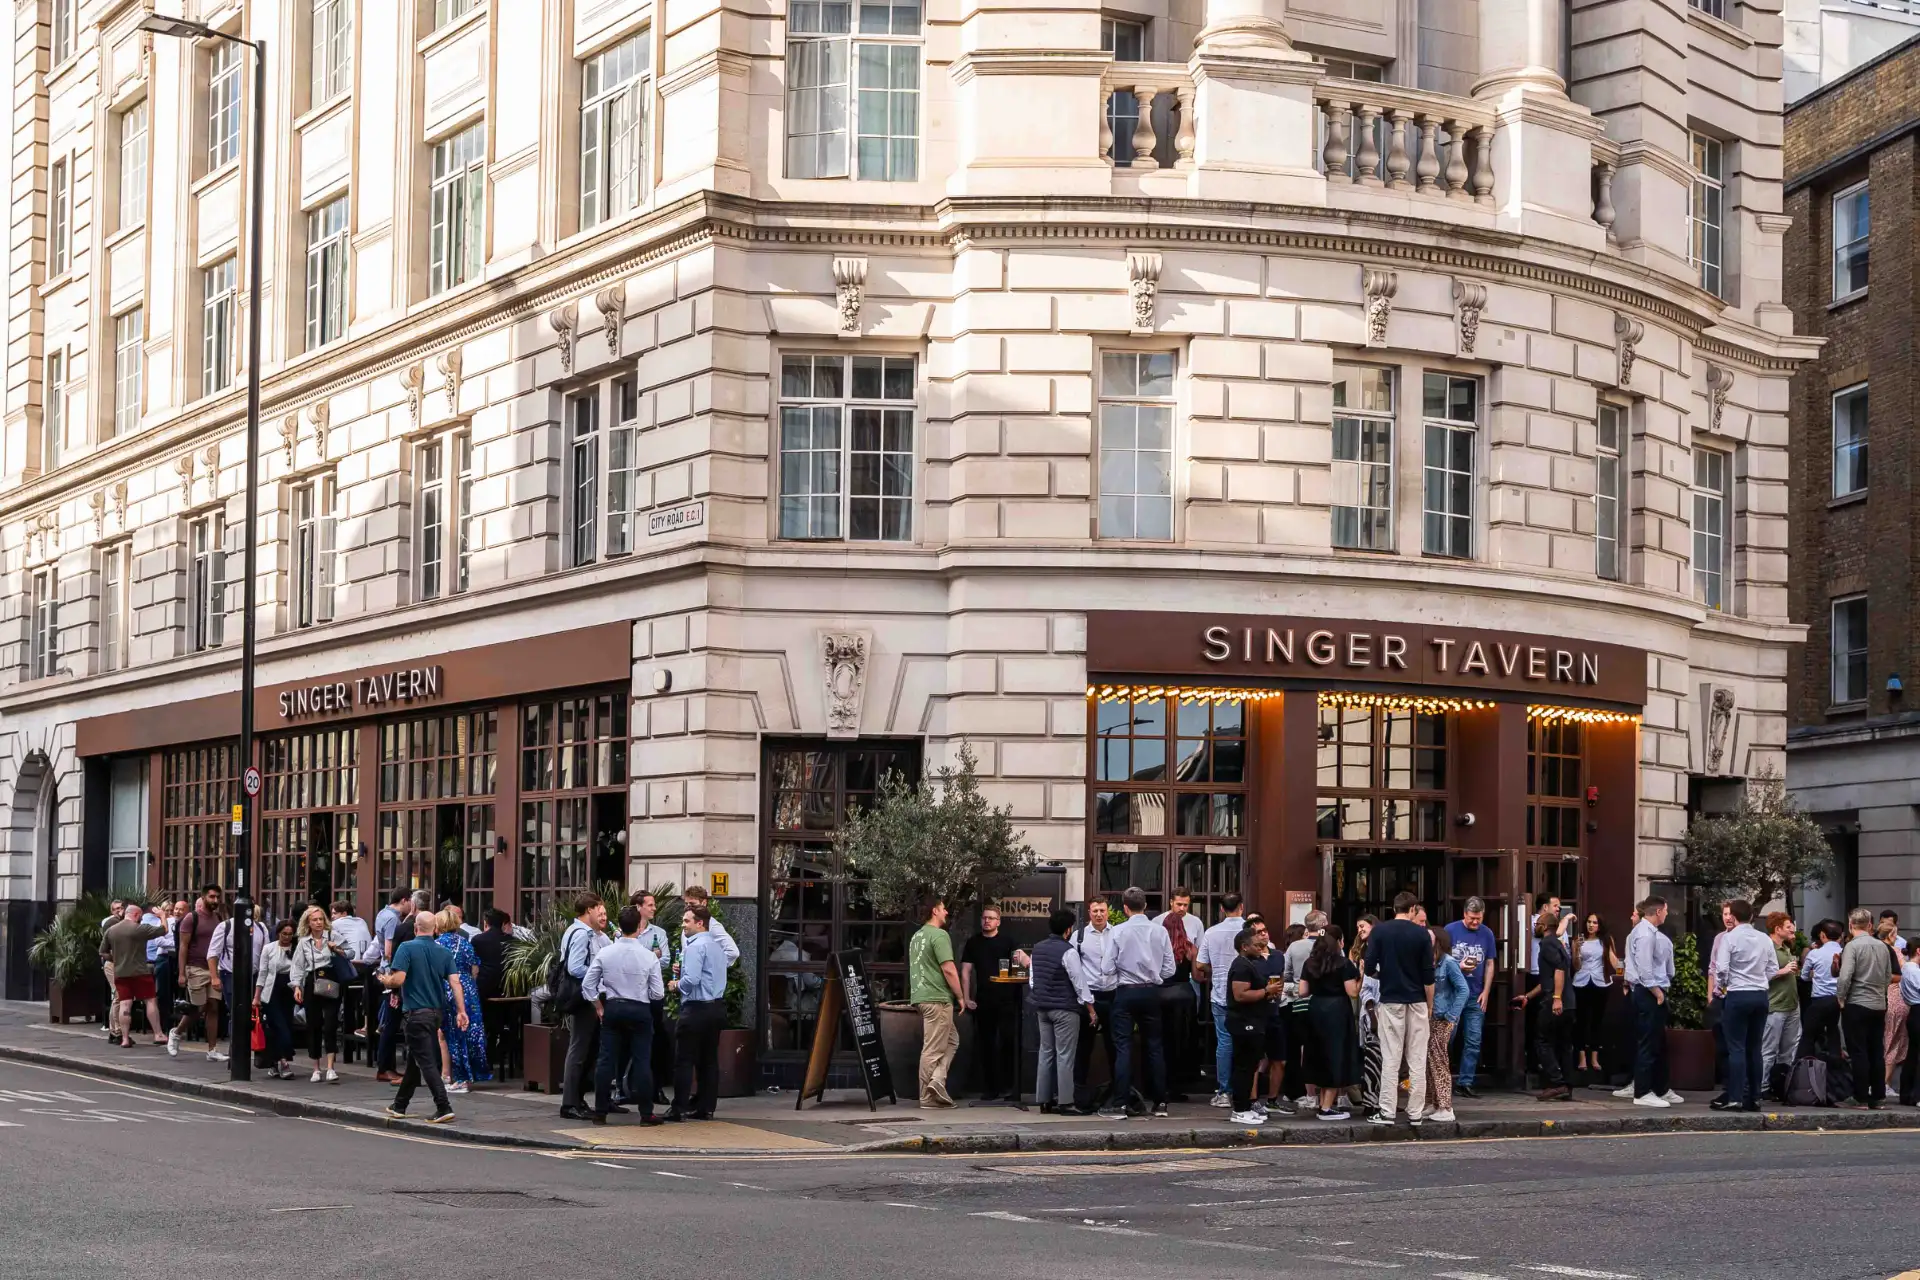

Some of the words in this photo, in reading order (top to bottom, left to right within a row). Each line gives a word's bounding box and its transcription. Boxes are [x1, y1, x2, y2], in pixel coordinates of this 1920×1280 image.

[651, 516, 666, 530] CITY
[667, 511, 684, 526] ROAD
[1203, 625, 1409, 670] SINGER
[1429, 637, 1600, 685] TAVERN
[279, 682, 346, 717] SINGER
[355, 666, 437, 705] TAVERN
[247, 775, 259, 789] 20
[713, 874, 726, 893] H
